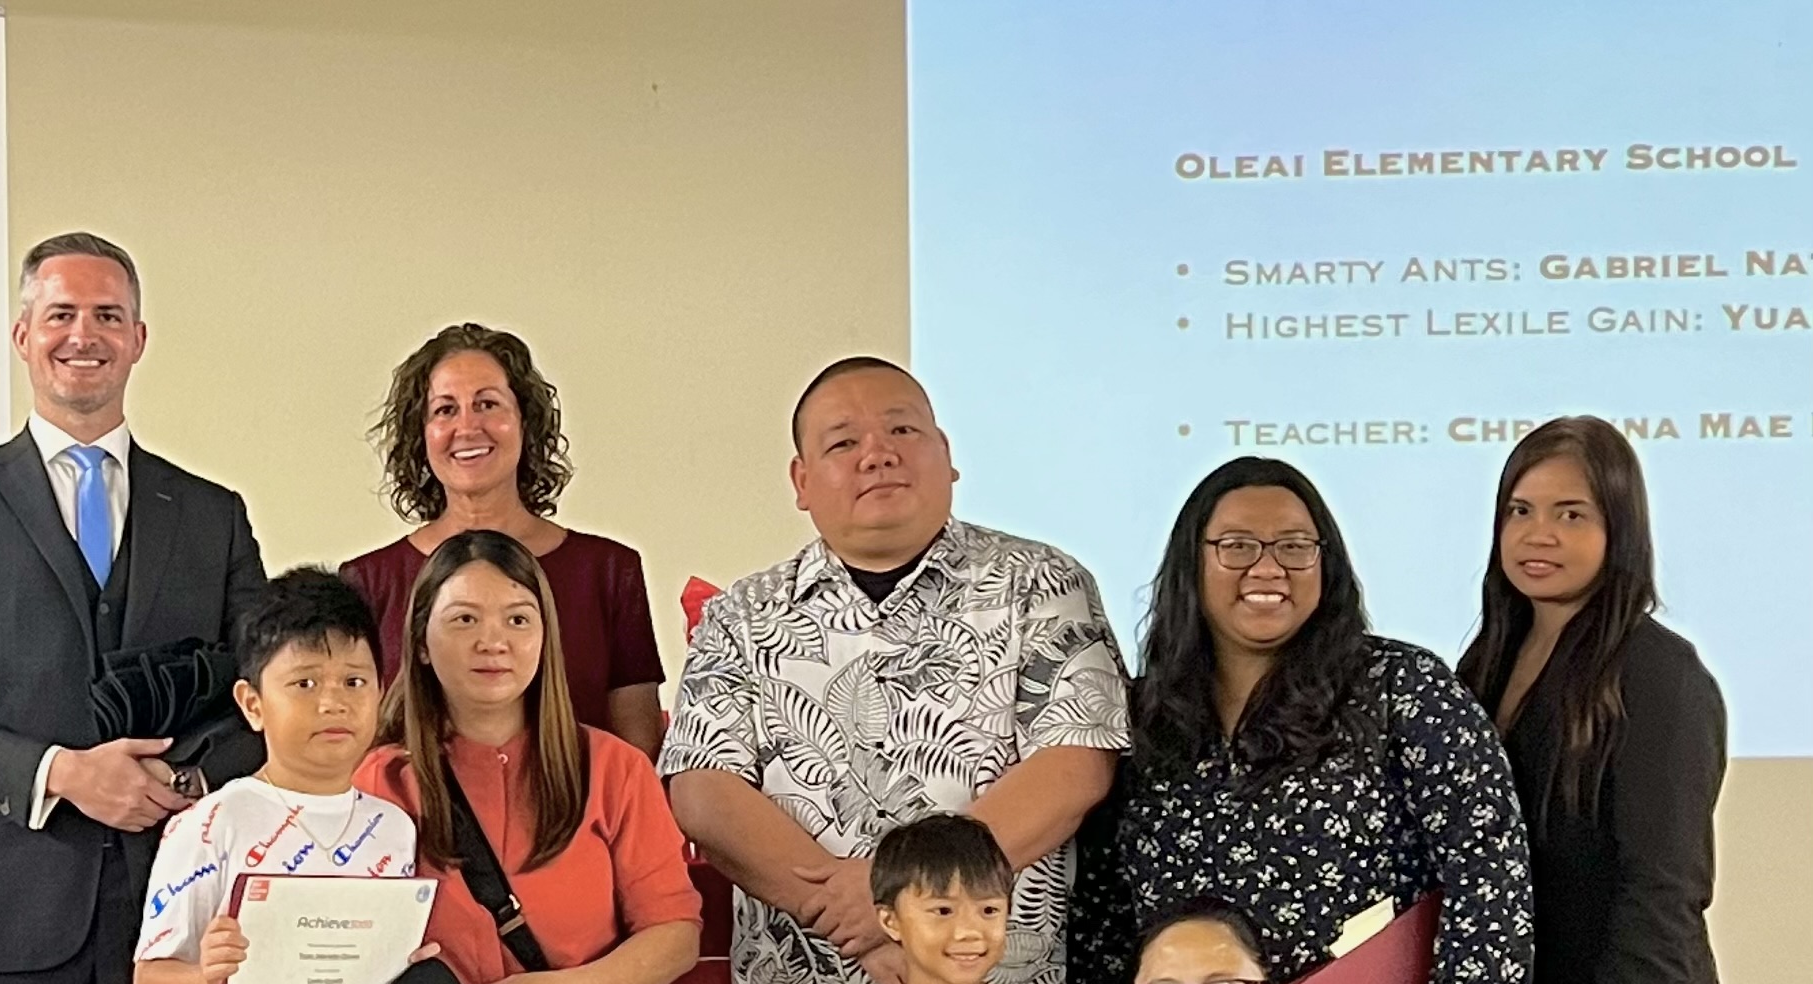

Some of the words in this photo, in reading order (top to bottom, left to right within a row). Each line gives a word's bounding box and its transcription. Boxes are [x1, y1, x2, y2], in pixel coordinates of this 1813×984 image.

[1174, 152, 1304, 179] OLEAI
[1323, 148, 1608, 177] ELEMENTARY
[1626, 143, 1797, 170] SCHOOL
[1224, 258, 1384, 286] SMARTY
[1400, 256, 1521, 283] ANTS:
[1539, 252, 1728, 280] GABRIEL
[1745, 250, 1813, 276] NA
[1226, 312, 1409, 340] HIGHEST
[1427, 308, 1570, 337] LEXILE
[1587, 305, 1703, 333] GAIN:
[1225, 418, 1429, 447] TEACHER:
[1699, 412, 1793, 439] MAE
